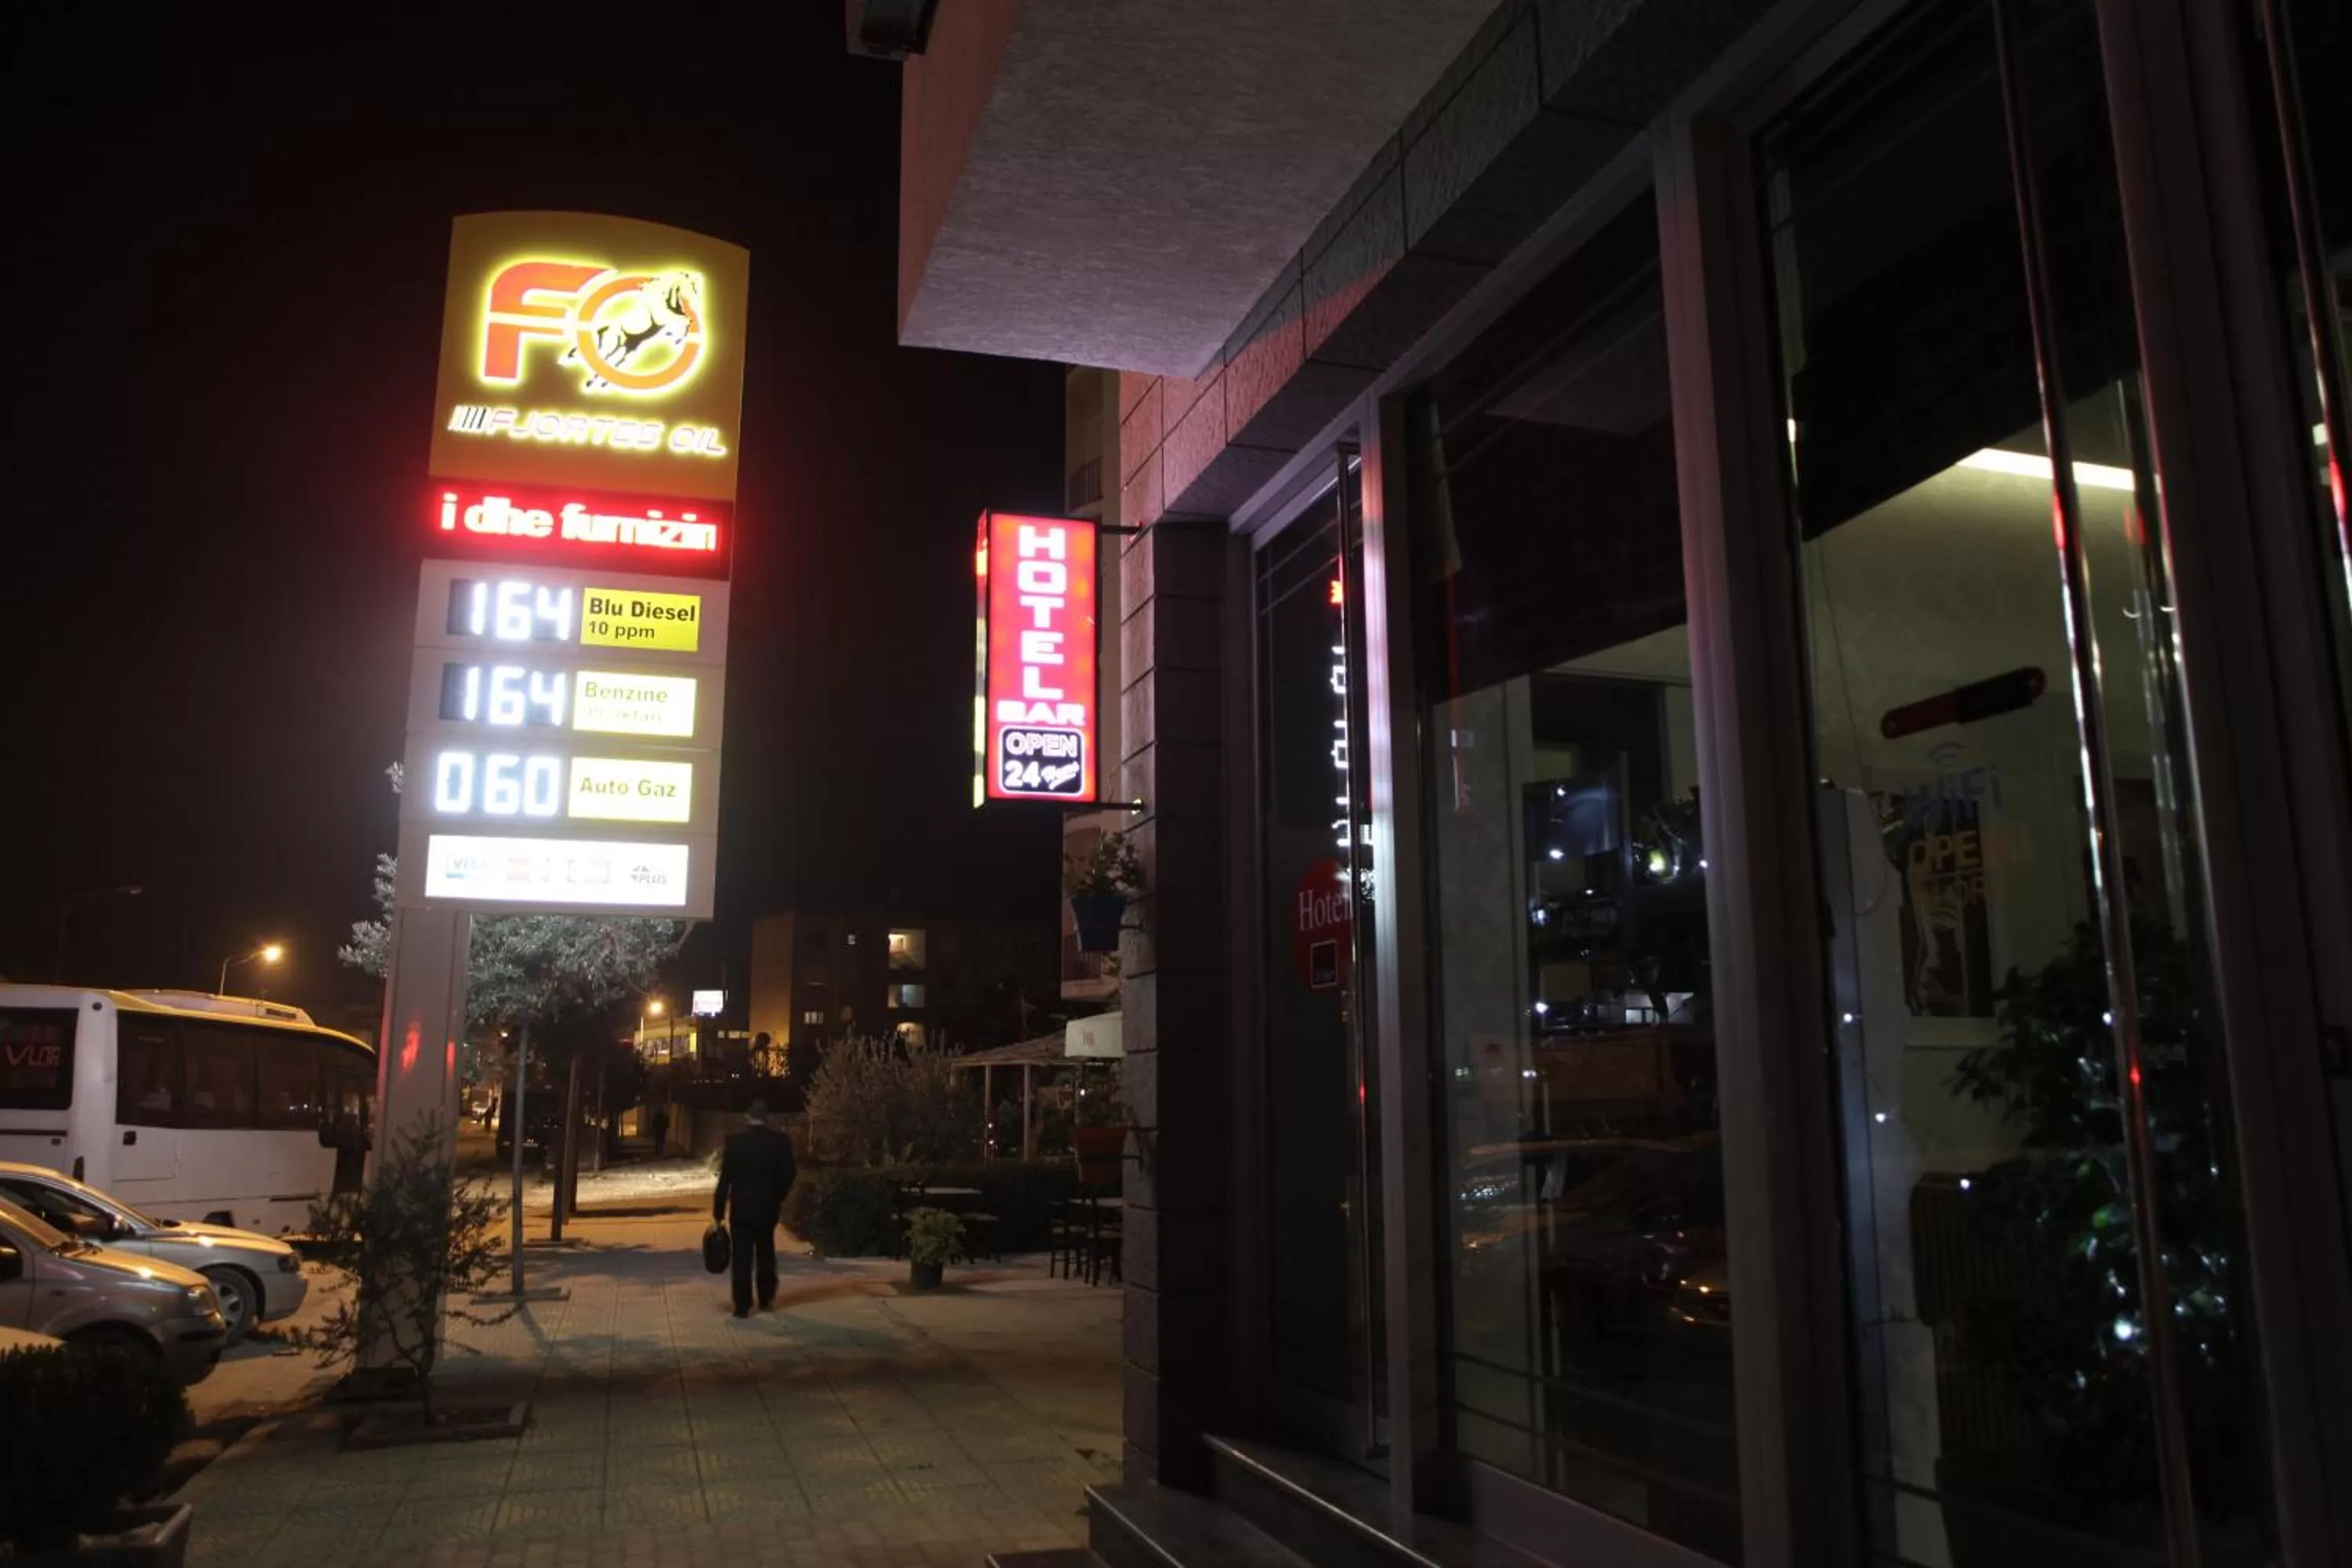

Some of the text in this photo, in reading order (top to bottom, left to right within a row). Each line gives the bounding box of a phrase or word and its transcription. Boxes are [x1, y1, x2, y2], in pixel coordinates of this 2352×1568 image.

[668, 422, 728, 457] OIL
[441, 493, 459, 530] i
[470, 580, 572, 641] 164
[590, 597, 695, 622] Blu Diesel
[1017, 524, 1068, 700] HOTEL
[590, 620, 655, 641] 10 ppm
[464, 665, 566, 726] 164
[584, 681, 668, 703] Benzine
[997, 700, 1085, 726] BAR
[1005, 731, 1078, 758] OPEN
[434, 751, 562, 817] 060
[579, 777, 677, 797] Auto Gaz
[1004, 760, 1041, 788] 24
[1298, 887, 1350, 931] Hotel
